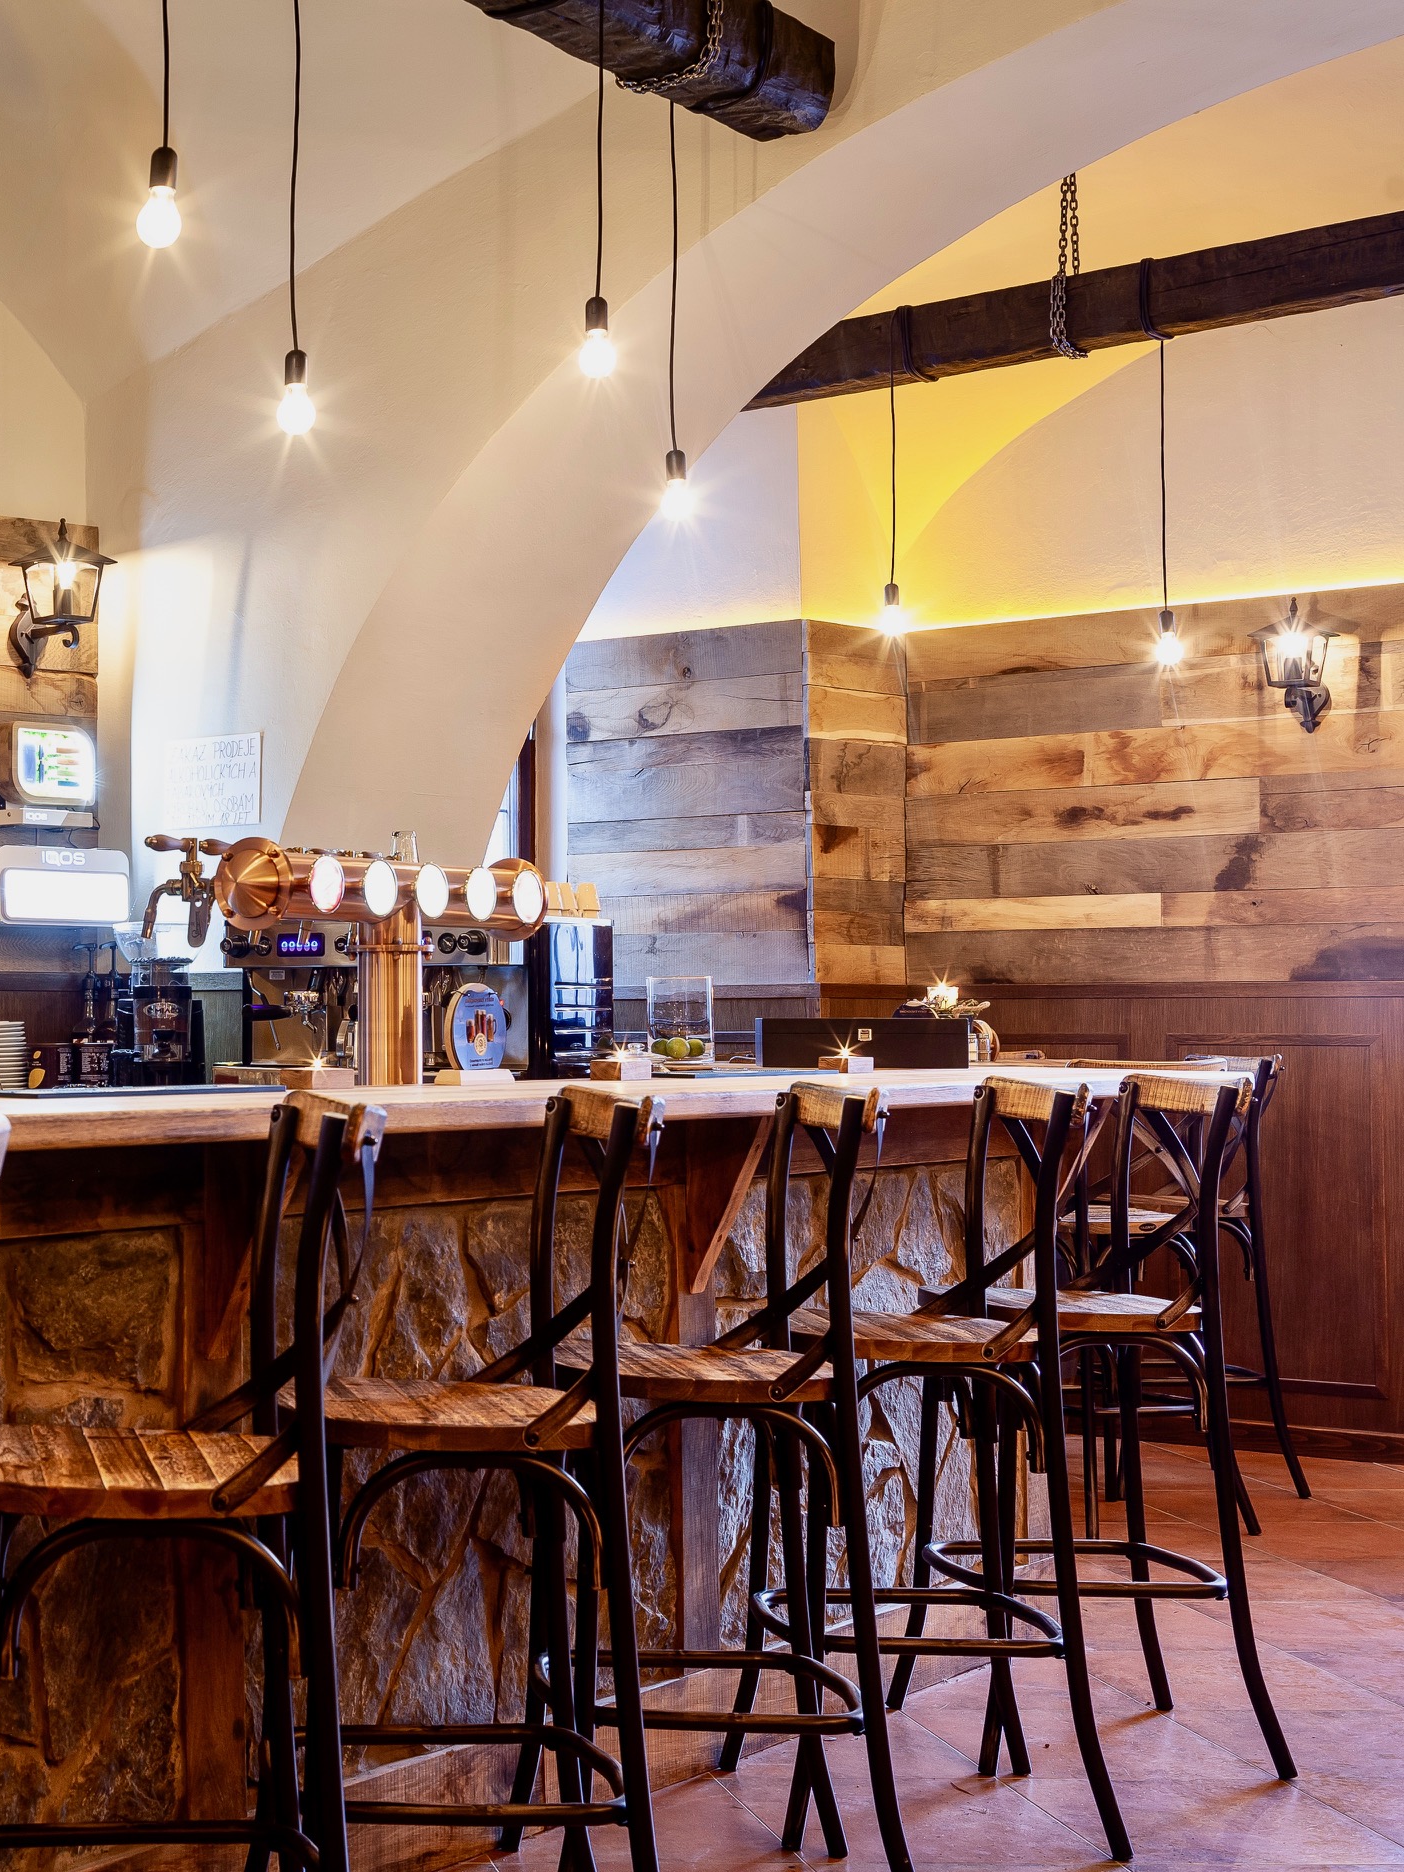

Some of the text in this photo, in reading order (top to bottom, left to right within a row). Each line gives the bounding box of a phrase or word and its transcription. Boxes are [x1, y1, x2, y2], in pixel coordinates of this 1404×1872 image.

[212, 738, 256, 759] PRODEJE
[248, 762, 256, 778] A
[214, 793, 254, 813] OSOBÁM
[221, 812, 230, 826] 18
[232, 811, 251, 825] LET
[42, 850, 86, 867] IQOS
